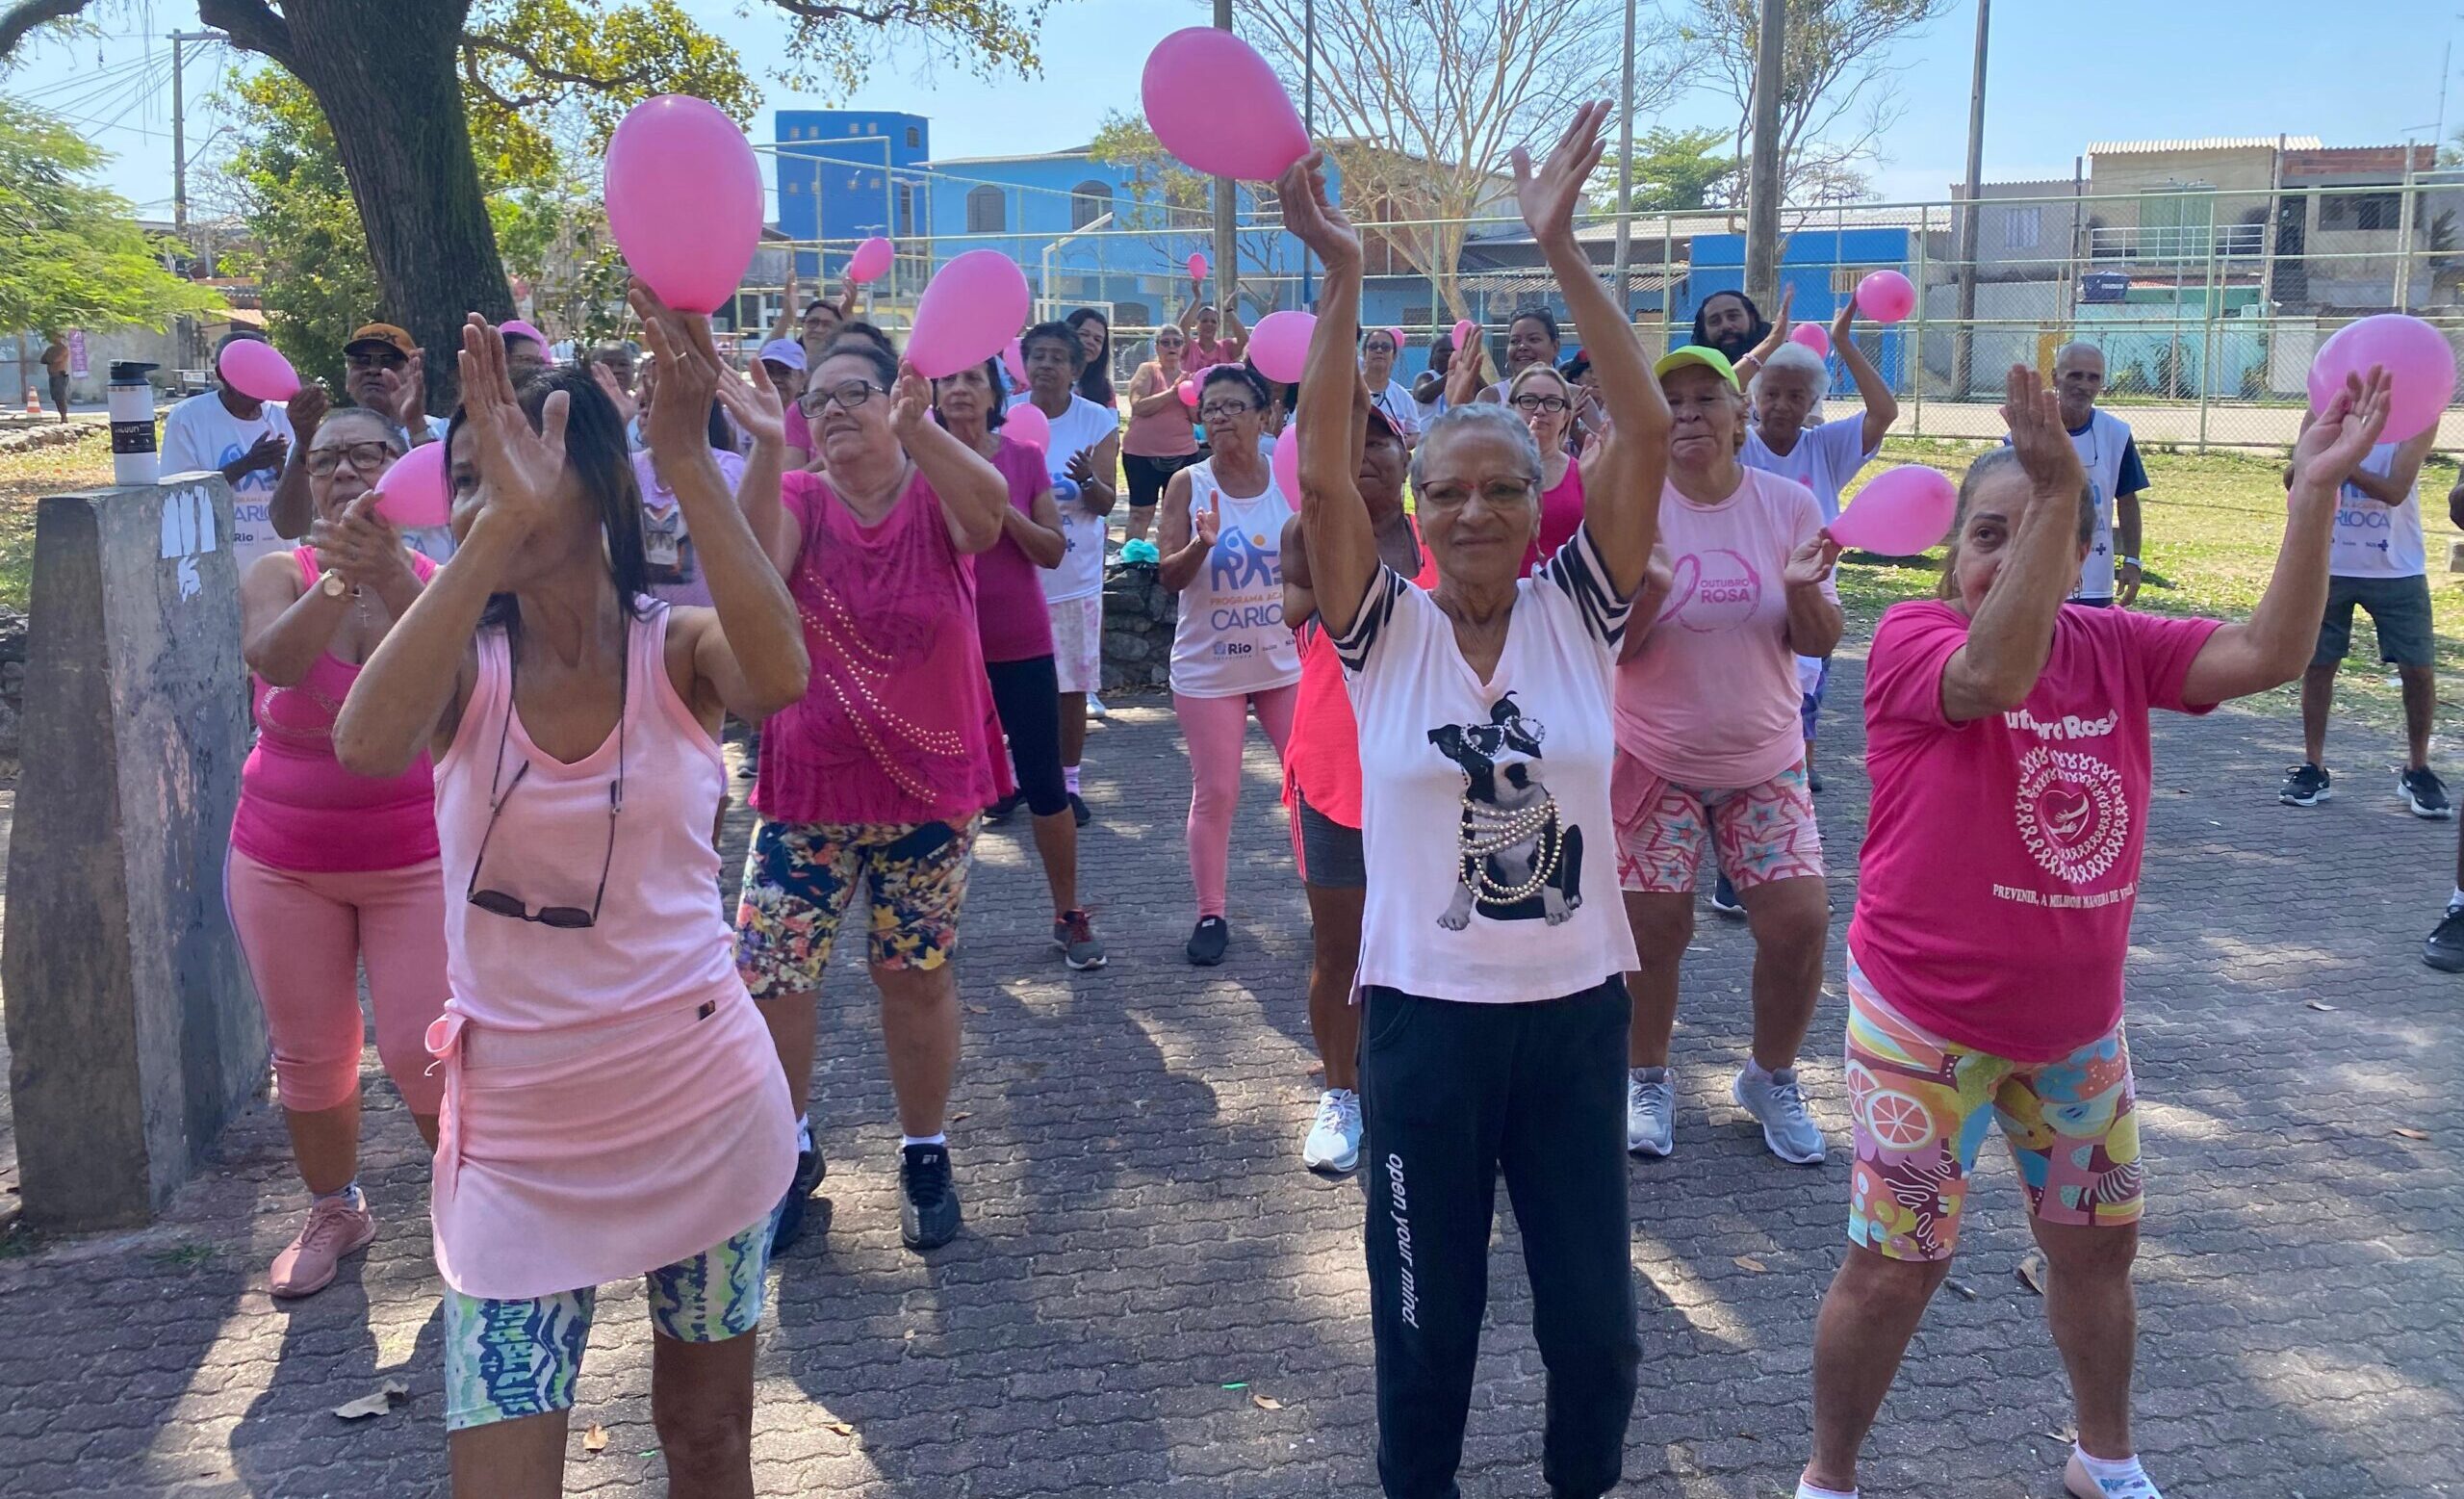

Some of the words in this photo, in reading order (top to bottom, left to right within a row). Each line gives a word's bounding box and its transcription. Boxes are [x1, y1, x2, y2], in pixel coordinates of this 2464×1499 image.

[2336, 509, 2391, 529] RIOCA
[1701, 579, 1749, 588] OUTUBRO
[1210, 594, 1263, 606] PROGRAMA
[1702, 588, 1751, 604] ROSA
[1212, 604, 1284, 631] CARIO
[1228, 643, 1251, 655] Rio
[1992, 884, 2040, 906] PREVENIR,
[2040, 893, 2048, 906] A
[1385, 1152, 1407, 1211] open
[1390, 1210, 1413, 1268] your
[1400, 1266, 1420, 1330] mind.
